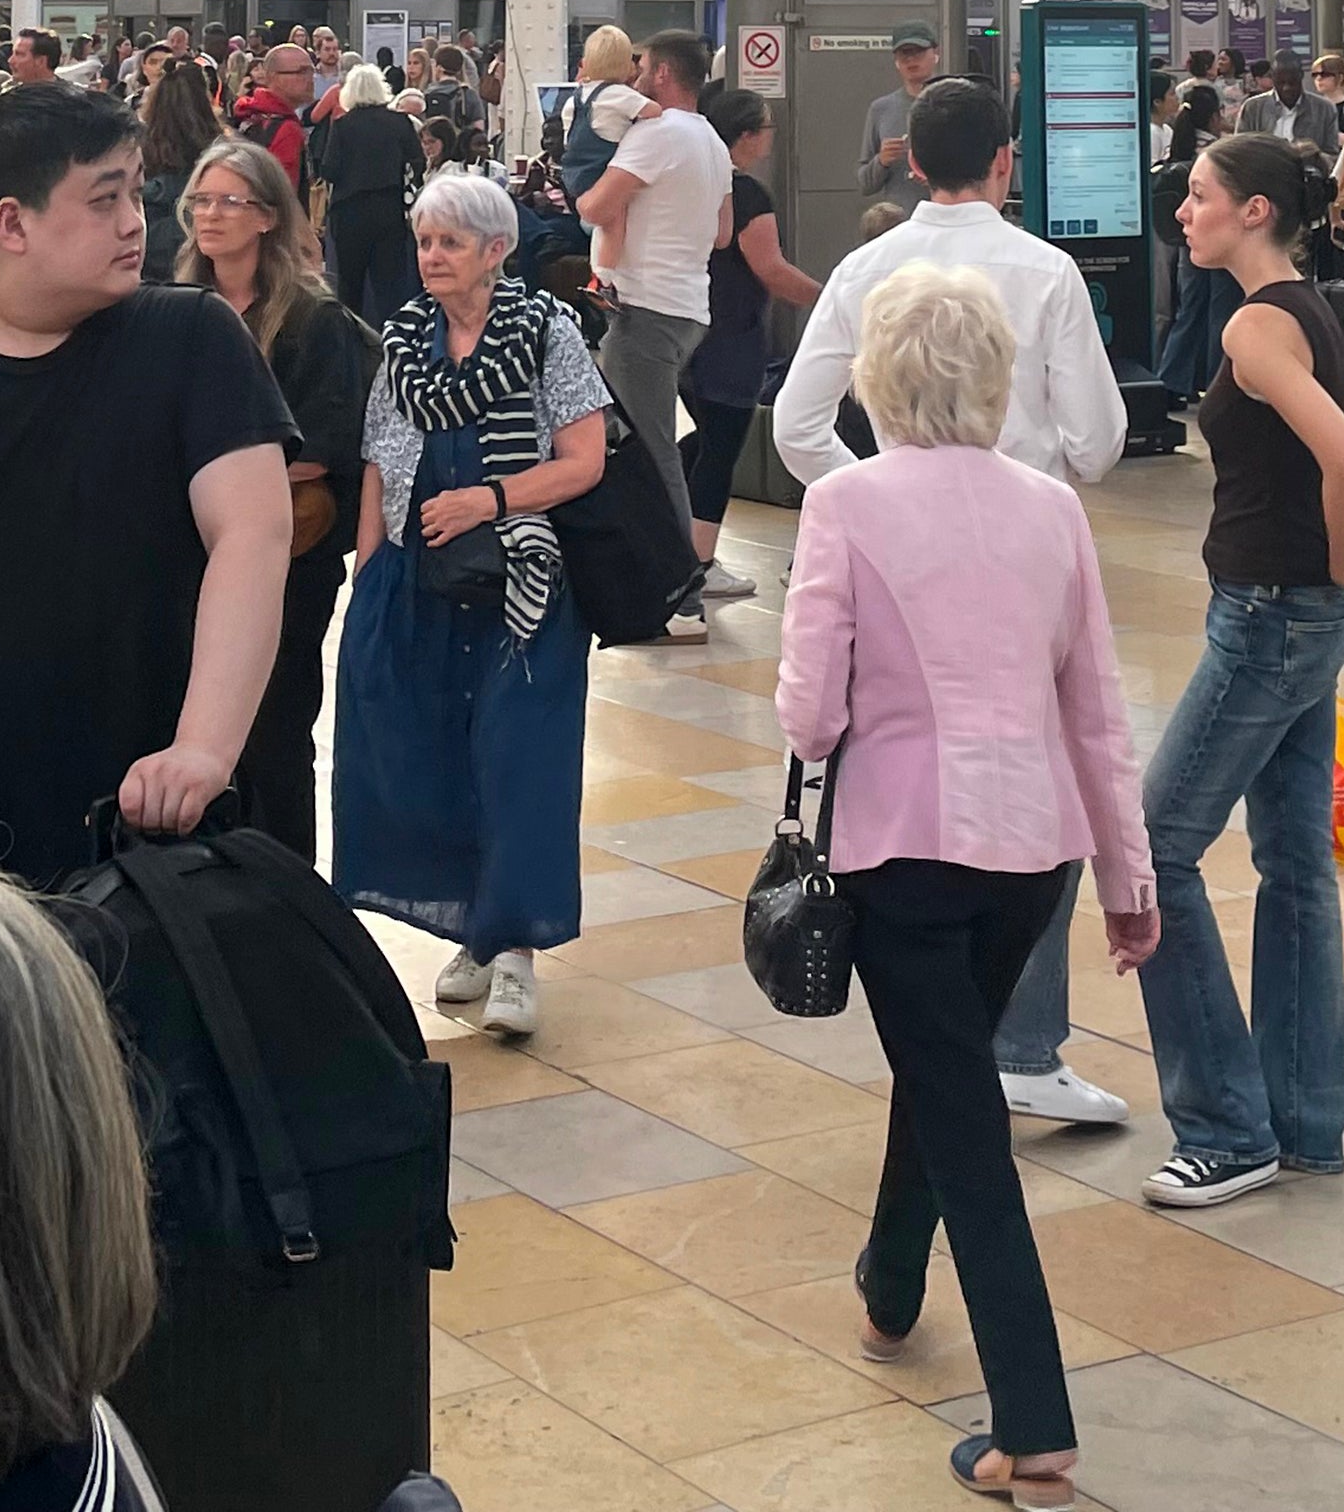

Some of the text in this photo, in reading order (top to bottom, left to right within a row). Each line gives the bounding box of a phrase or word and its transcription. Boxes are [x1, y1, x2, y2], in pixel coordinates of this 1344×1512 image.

[823, 39, 835, 48] No
[837, 38, 870, 49] smoking
[872, 39, 880, 47] in
